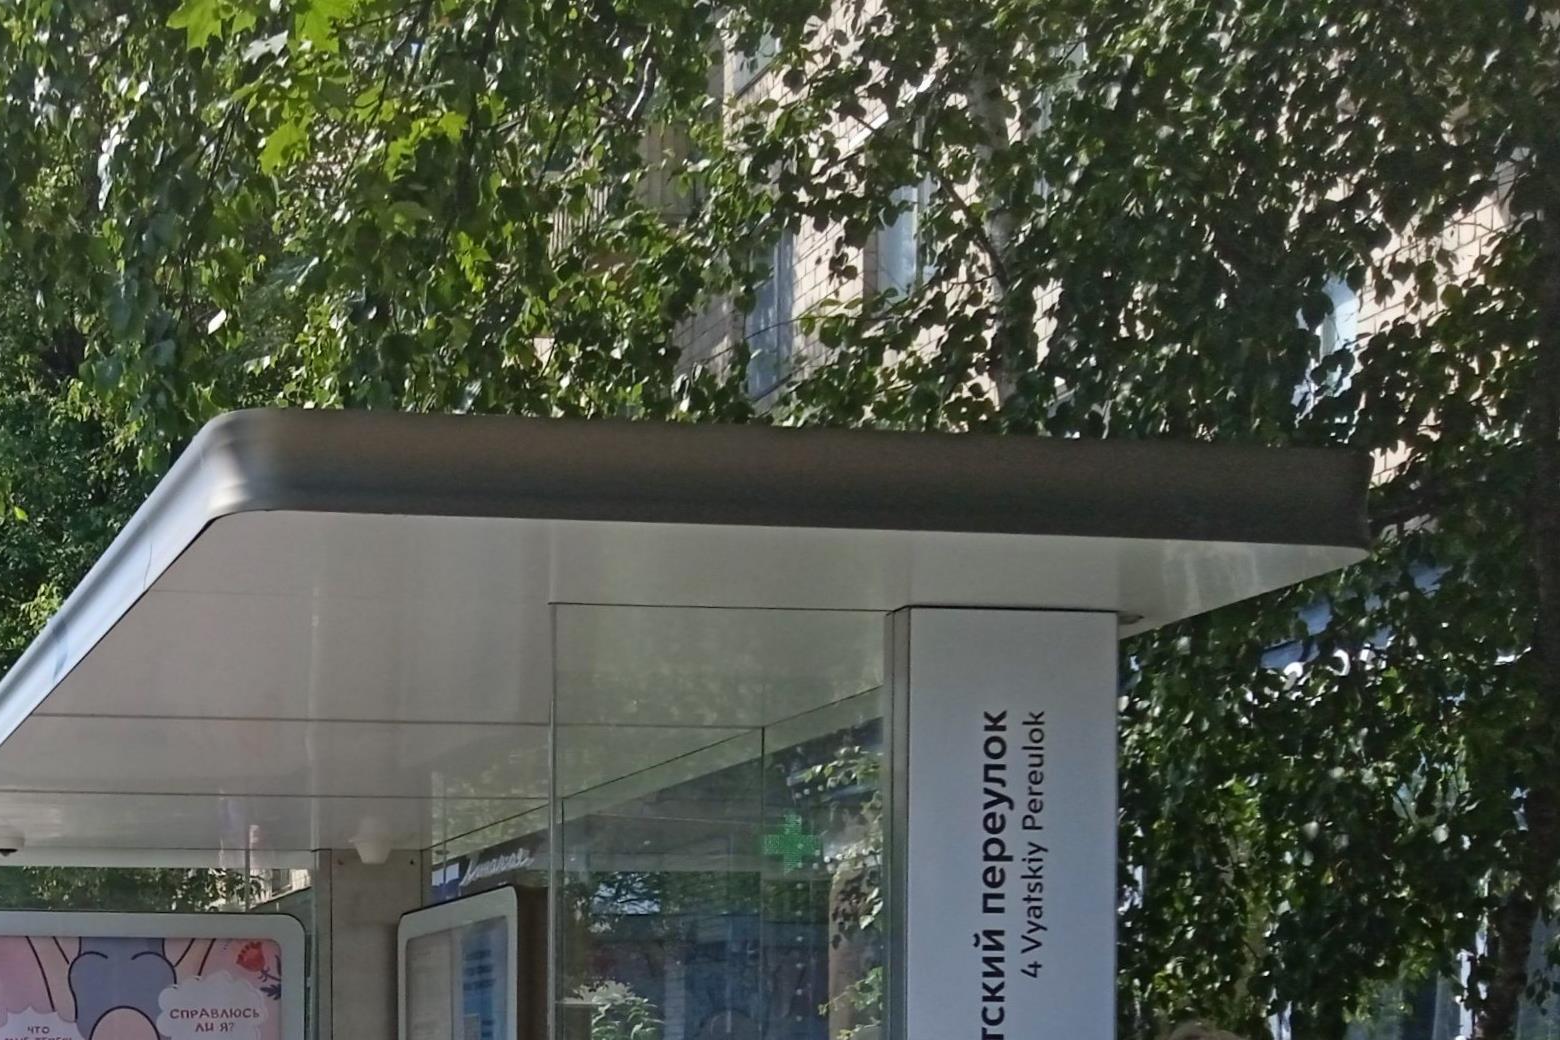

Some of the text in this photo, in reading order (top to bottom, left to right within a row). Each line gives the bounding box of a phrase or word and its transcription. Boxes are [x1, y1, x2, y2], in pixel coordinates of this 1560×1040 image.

[982, 710, 1014, 914] переулок
[1020, 711, 1048, 978] 4 Vyatskiy Pereulok
[169, 1008, 260, 1019] СПРАВЛЮСЬ
[27, 1026, 50, 1034] ЧТО
[195, 1022, 235, 1032] ЛИ Я?
